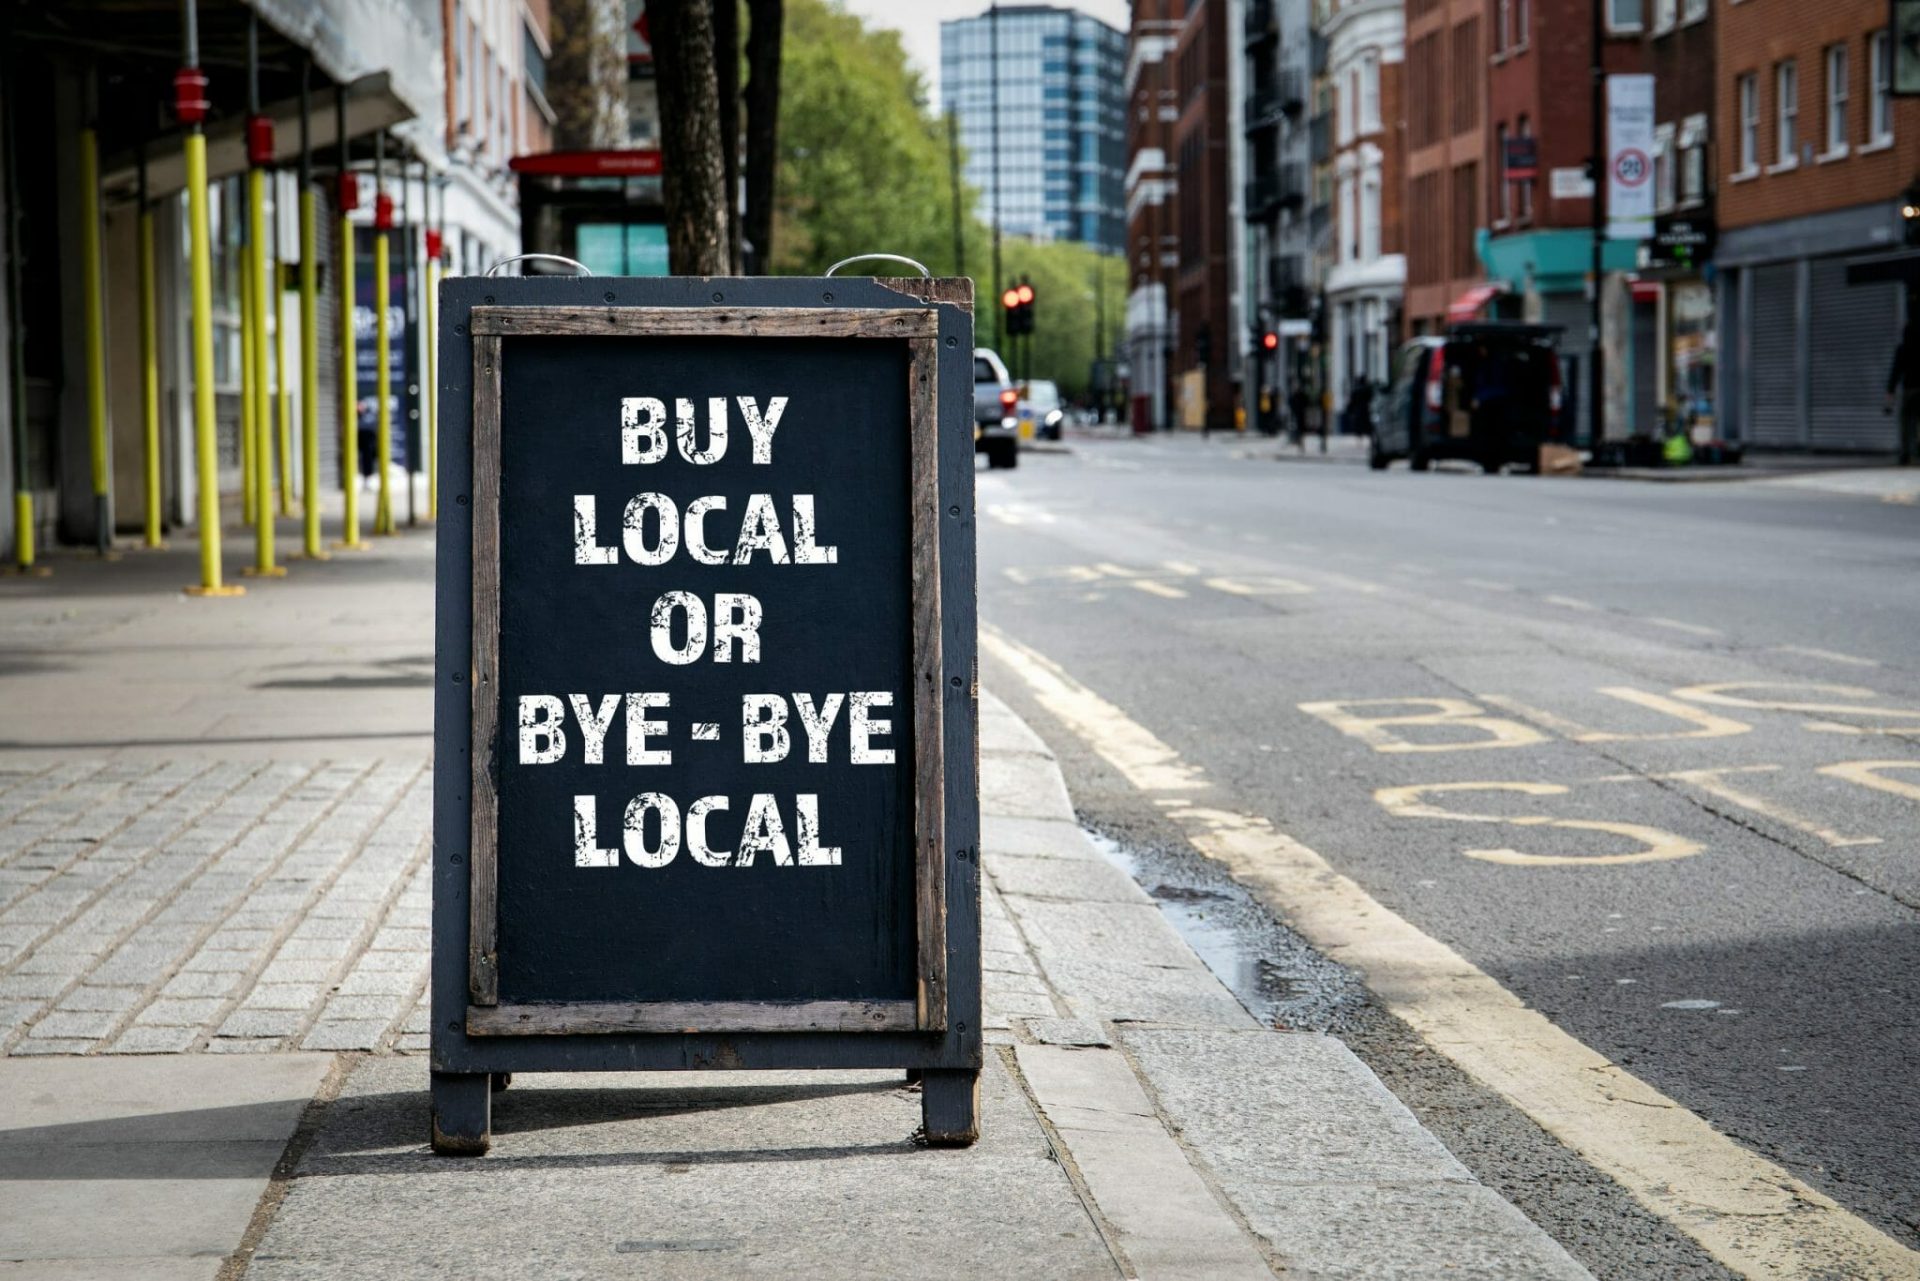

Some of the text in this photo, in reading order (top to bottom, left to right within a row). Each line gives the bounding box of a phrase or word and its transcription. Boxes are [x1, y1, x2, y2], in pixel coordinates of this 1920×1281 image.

[621, 396, 788, 465] BUY
[574, 493, 838, 566] LOCAL
[650, 590, 762, 664] OR
[518, 692, 671, 765] BYE
[743, 692, 896, 765] BYE
[1298, 681, 1920, 753] BUS
[574, 792, 842, 868] LOCAL
